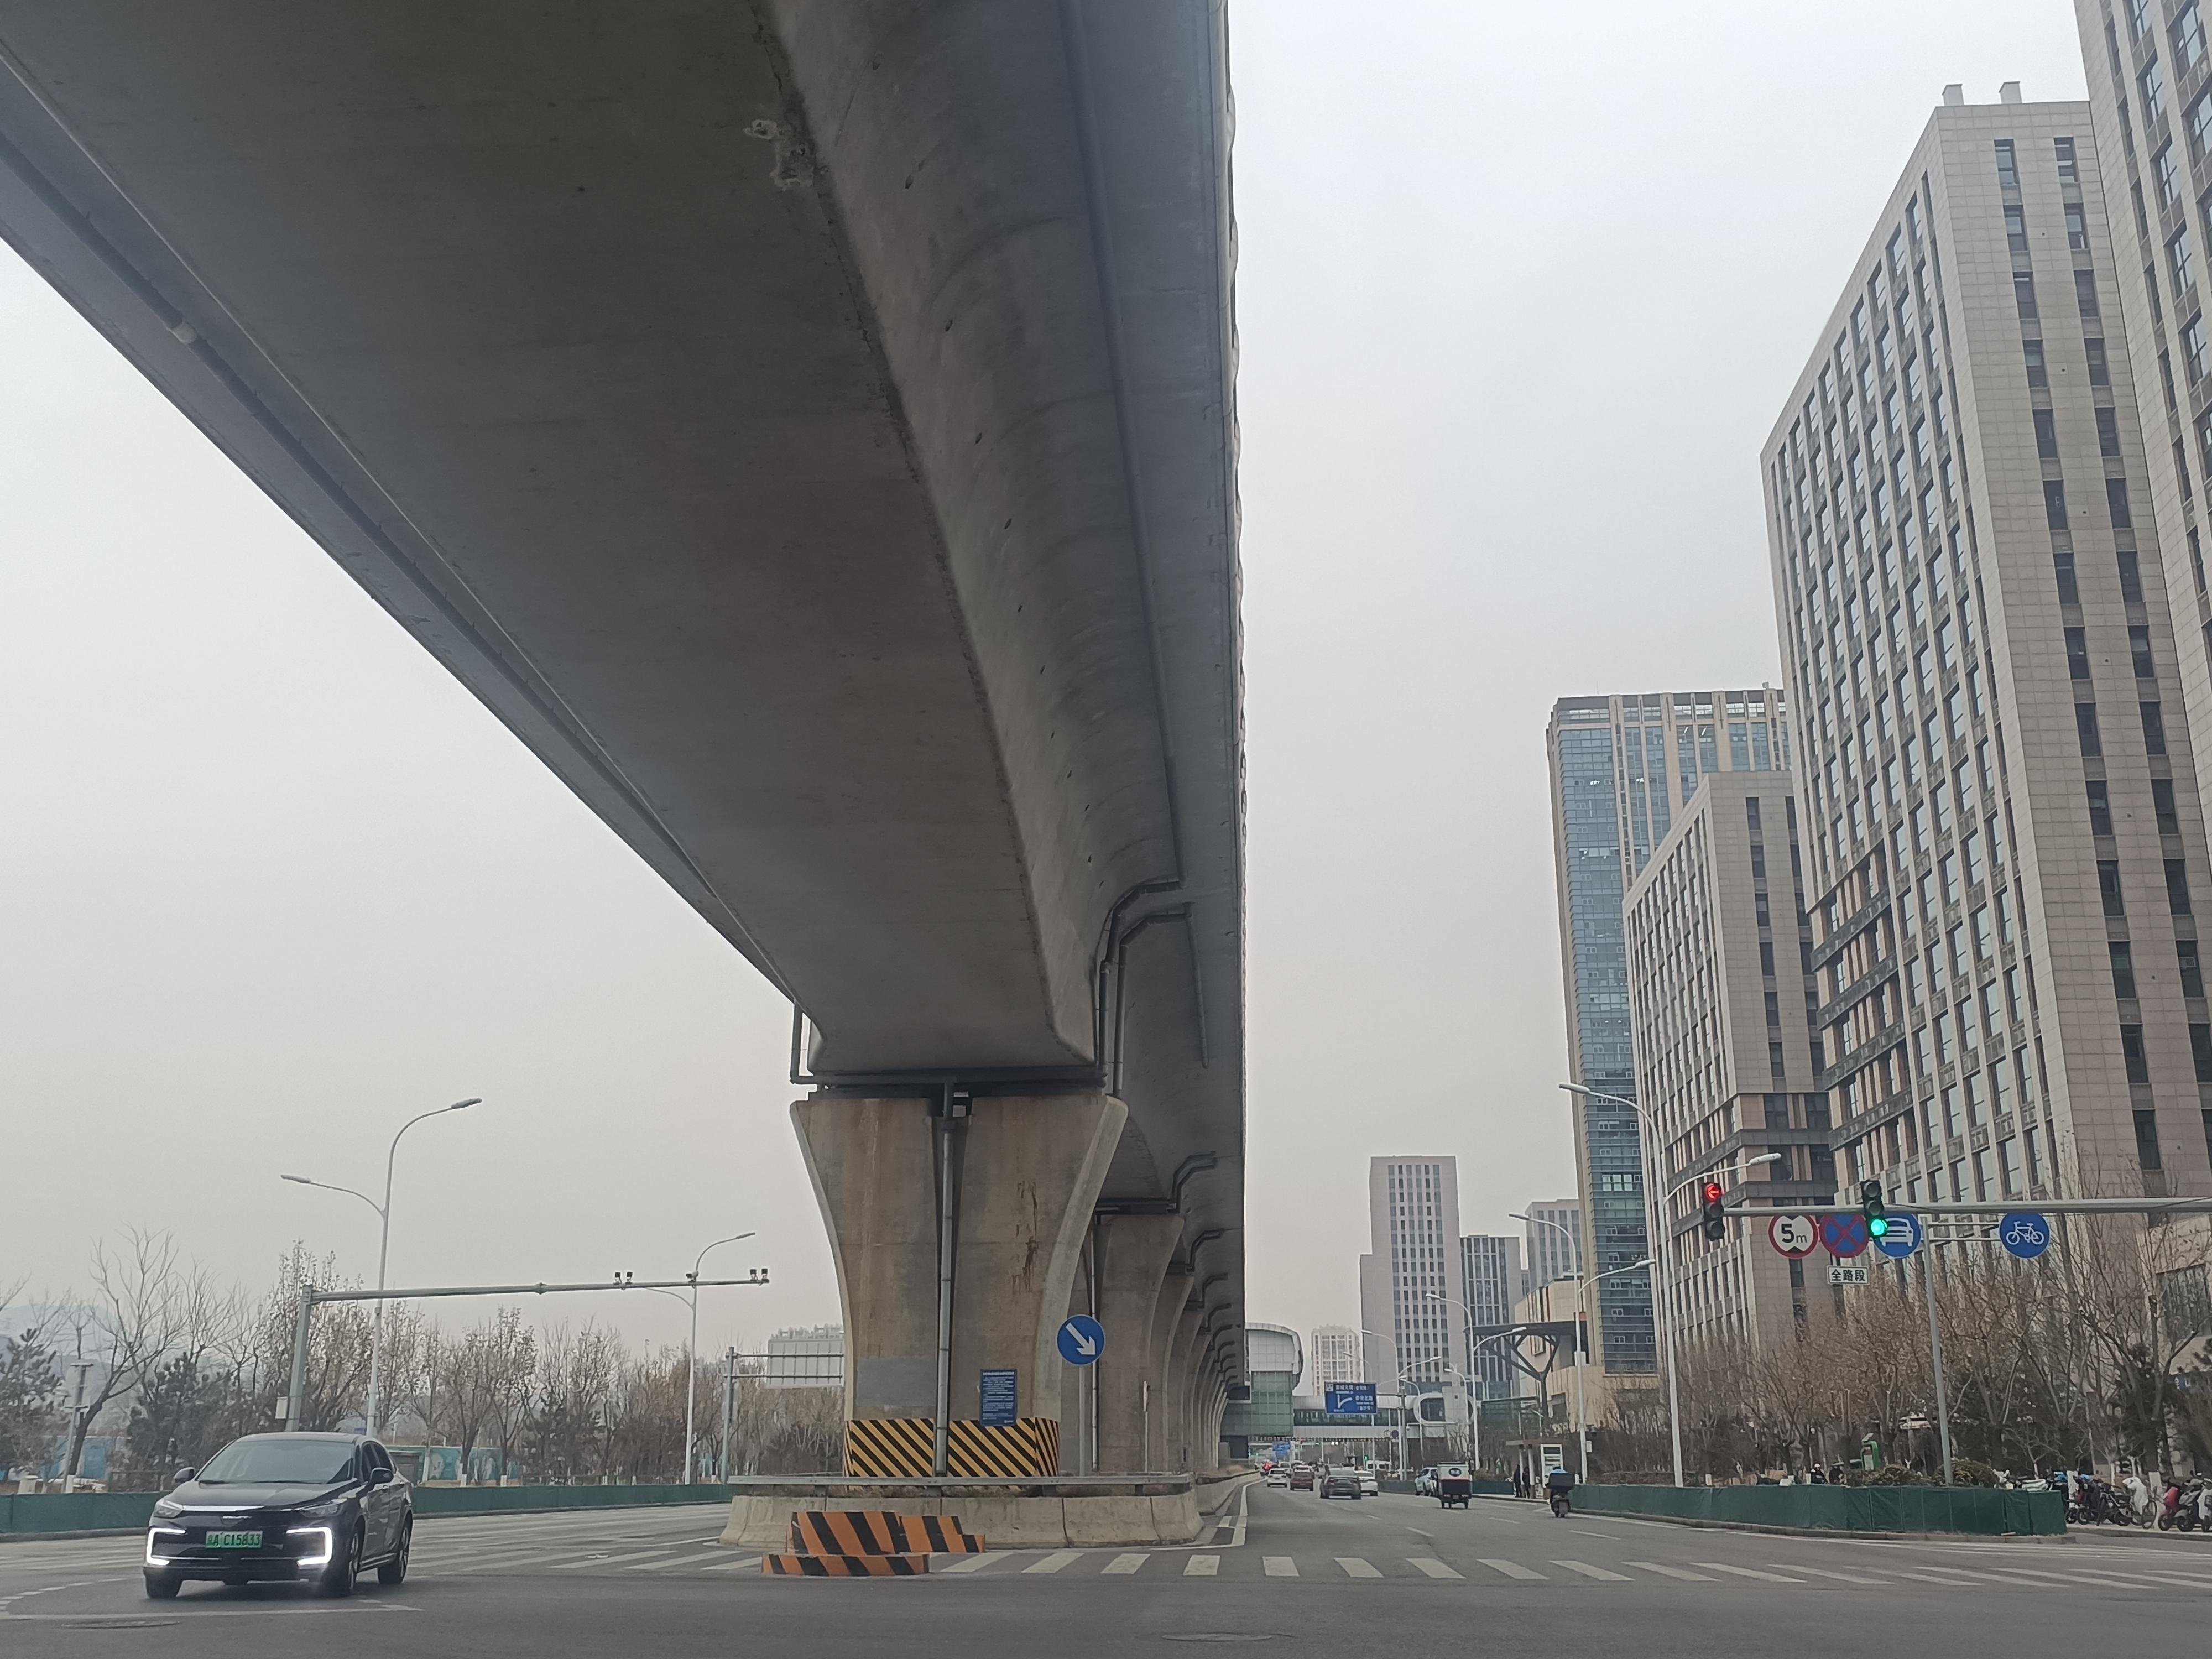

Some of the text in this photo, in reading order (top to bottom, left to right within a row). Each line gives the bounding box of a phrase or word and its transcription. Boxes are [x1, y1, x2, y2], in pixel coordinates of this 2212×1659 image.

[1781, 1224, 1807, 1243] 5m
[1831, 1269, 1865, 1282] 全路段
